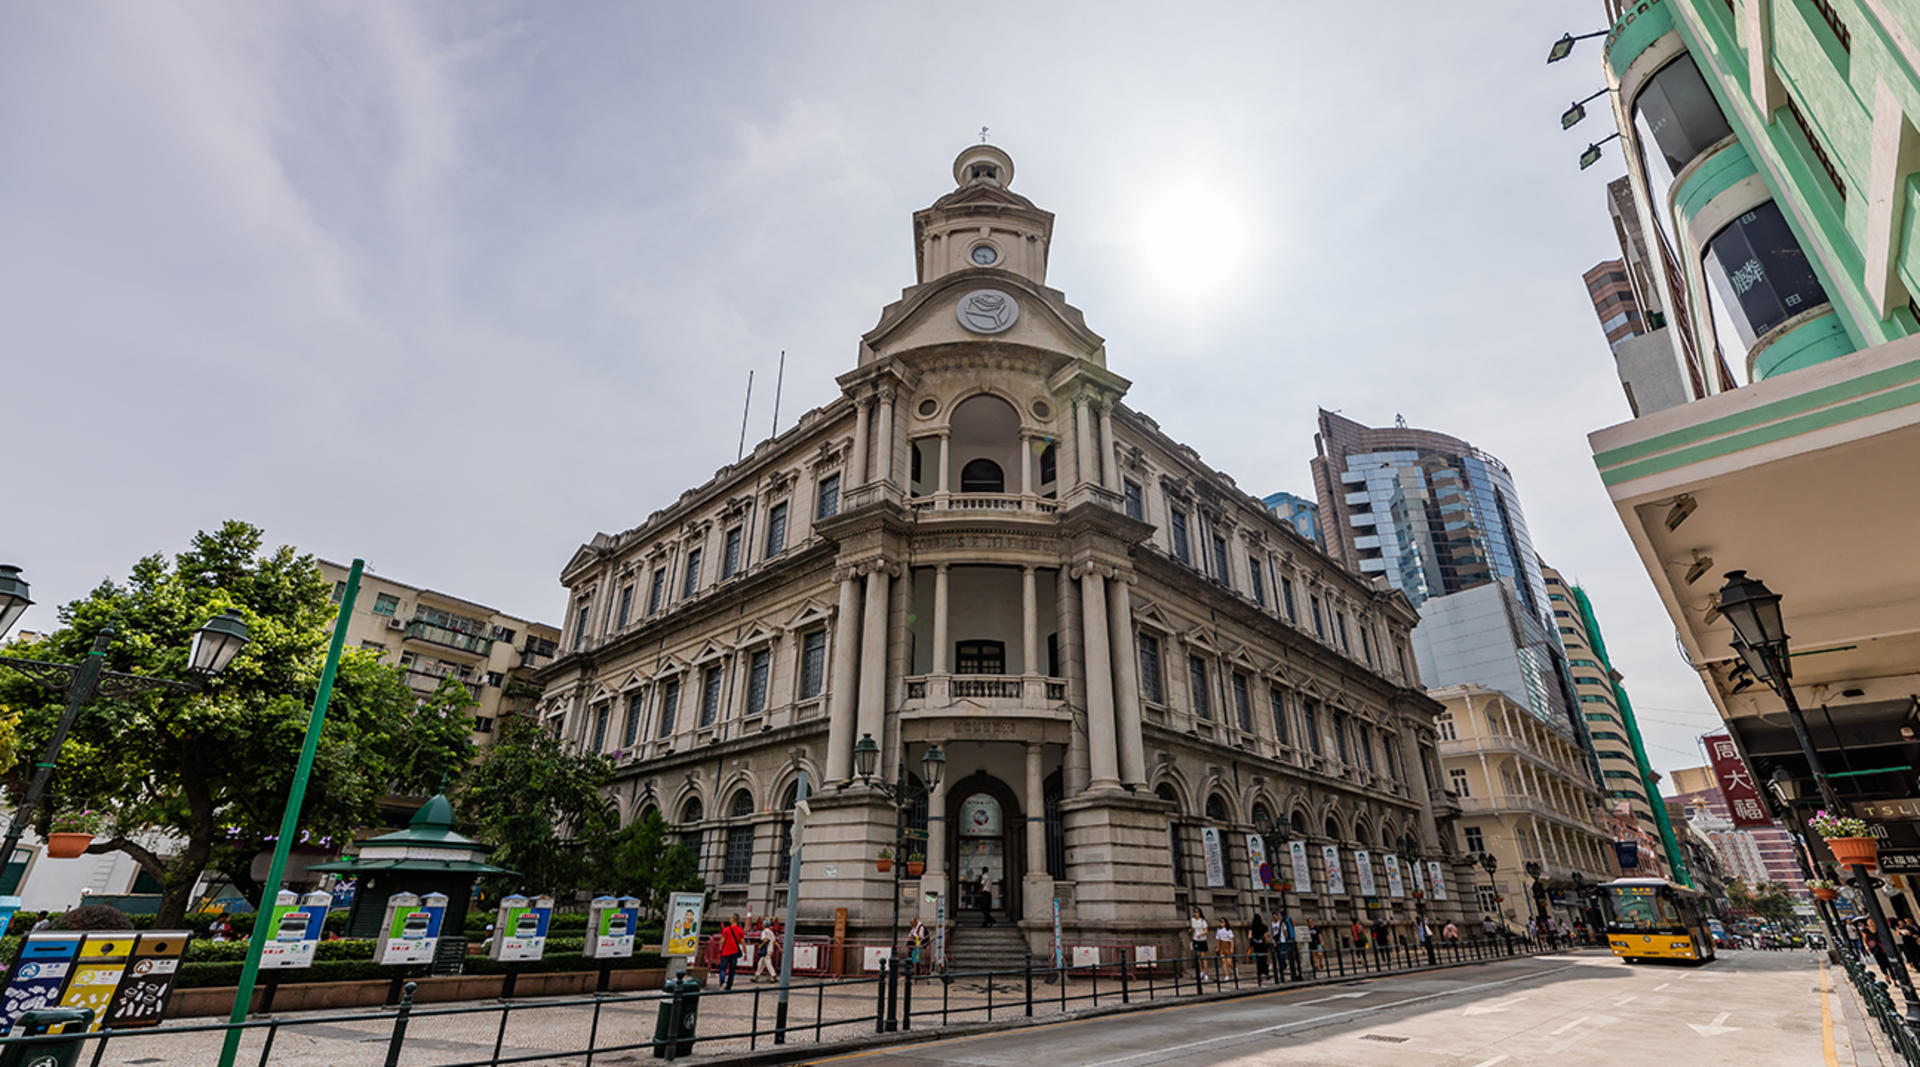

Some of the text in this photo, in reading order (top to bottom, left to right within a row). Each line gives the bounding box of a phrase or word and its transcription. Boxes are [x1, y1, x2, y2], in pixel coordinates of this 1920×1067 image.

[1713, 740, 1763, 820] 周大福
[1881, 855, 1920, 865] 六福珠
